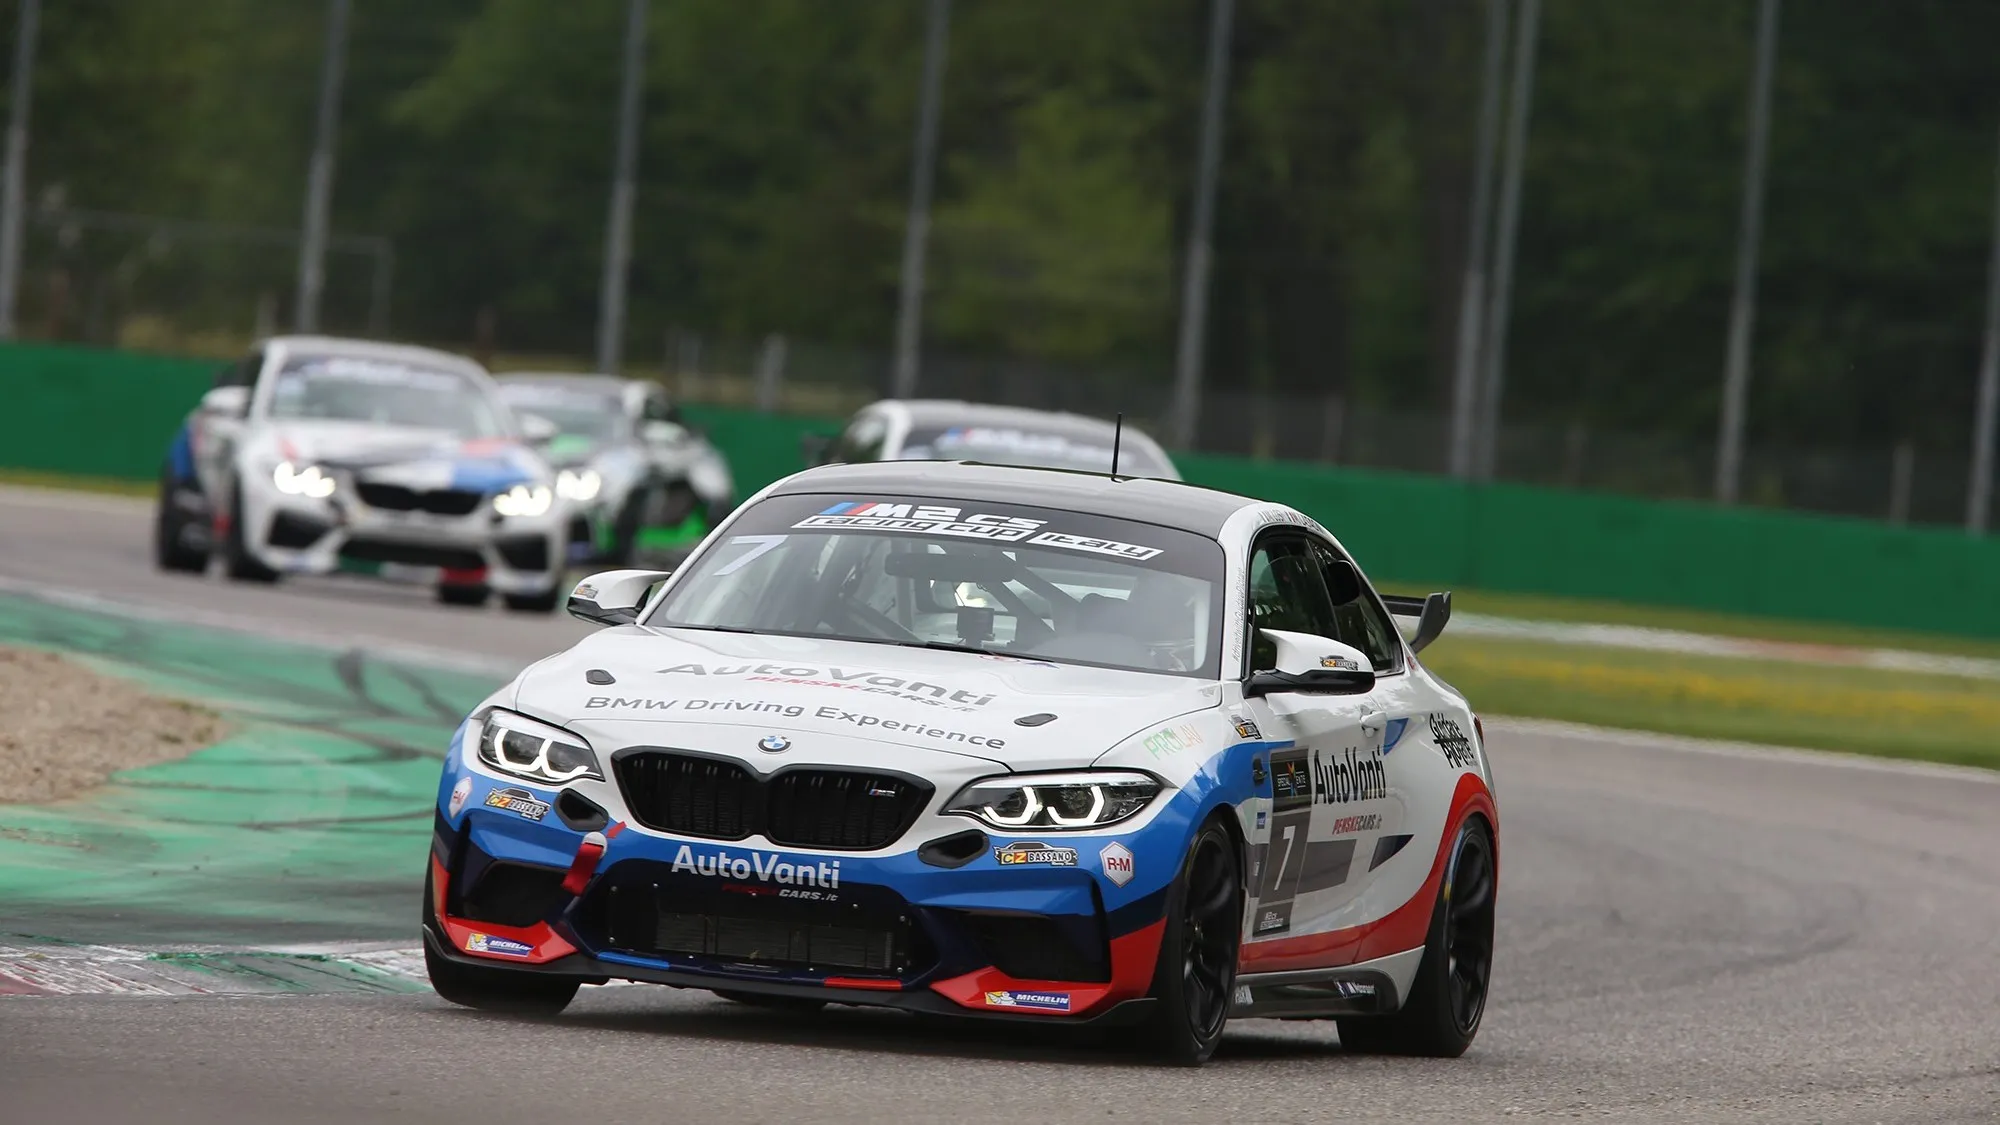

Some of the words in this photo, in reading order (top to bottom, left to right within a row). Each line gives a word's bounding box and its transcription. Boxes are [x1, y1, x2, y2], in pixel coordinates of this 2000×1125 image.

[808, 517, 937, 531] racing
[944, 523, 1024, 538] cup
[855, 503, 961, 522] M2
[965, 514, 1048, 530] CS
[713, 534, 788, 576] 7
[1042, 534, 1153, 558] Italy
[655, 663, 997, 706] AutoVanti
[584, 696, 678, 710] BMW
[684, 699, 805, 718] Driving
[815, 705, 1006, 750] Experience
[1314, 744, 1386, 805] AutoVanti
[671, 845, 840, 889] AutoVanti
[1002, 852, 1027, 864] CZ
[1027, 851, 1072, 862] BASSANO
[1107, 857, 1131, 872] R-M
[1273, 823, 1296, 891] 7
[1016, 993, 1068, 1004] MICHELIN
